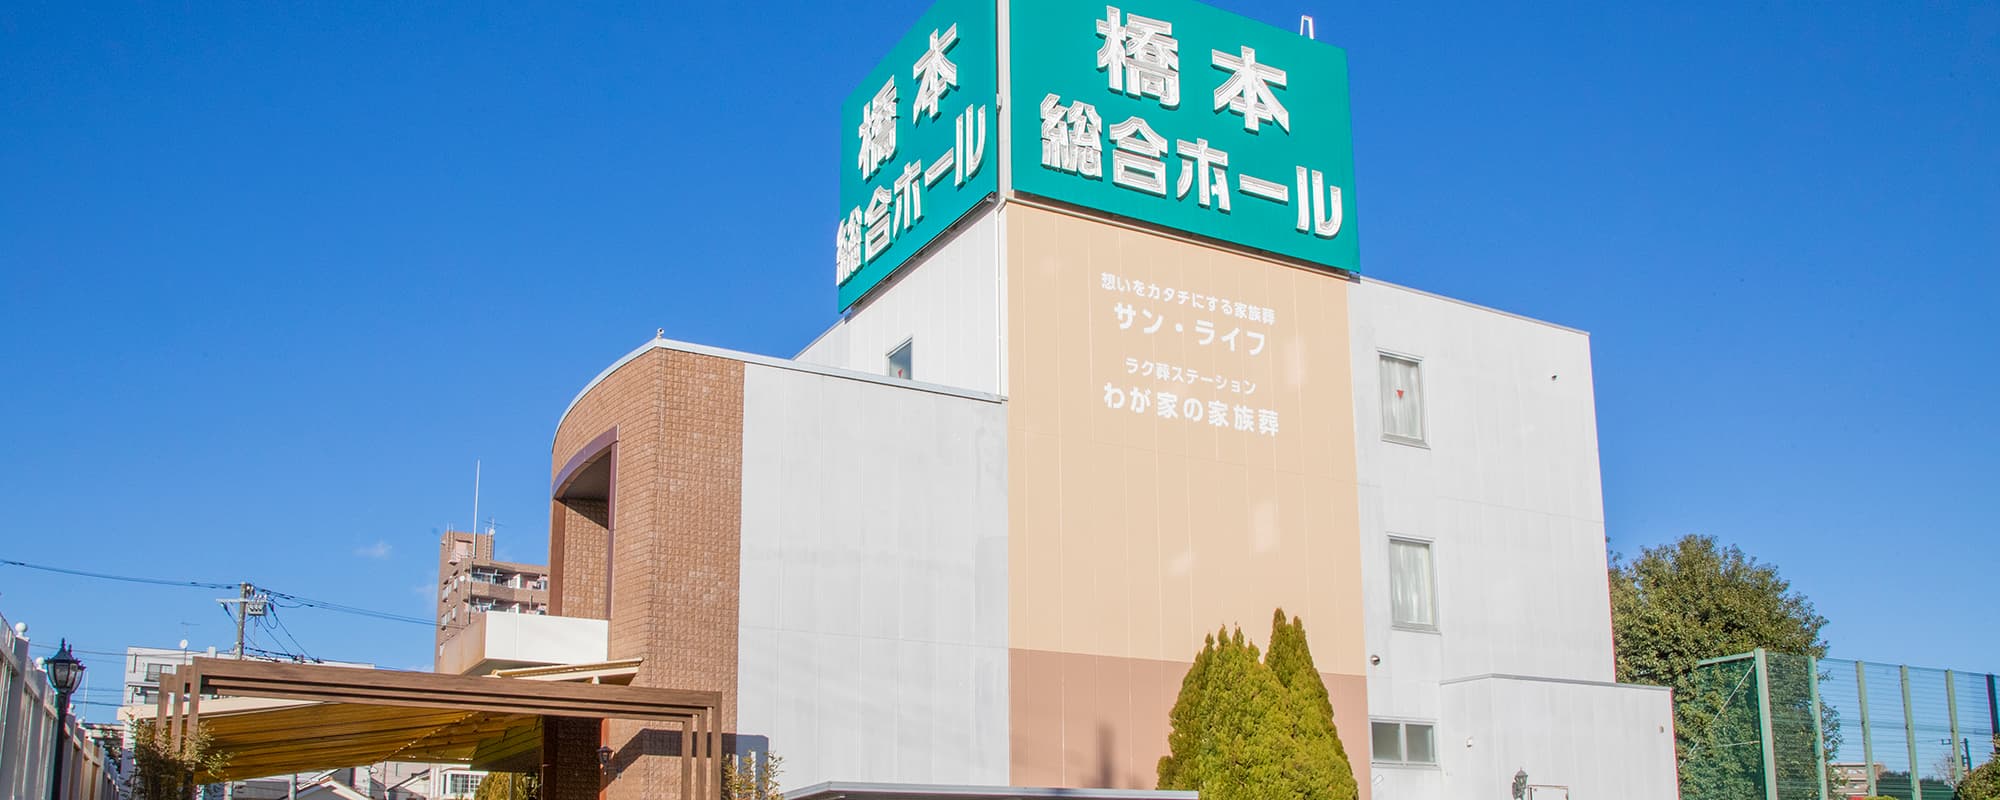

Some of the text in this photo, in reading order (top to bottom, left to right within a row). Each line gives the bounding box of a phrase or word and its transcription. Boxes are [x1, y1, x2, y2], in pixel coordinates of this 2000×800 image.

[858, 22, 957, 181] 橋本
[1096, 5, 1290, 134] 橋本
[836, 103, 986, 287] 総合ホール
[1040, 93, 1343, 239] 総合ホール
[1101, 272, 1276, 325] 想いをカタチにする家族葬
[1114, 302, 1265, 355] サン・ライフ
[1104, 382, 1279, 436] わが家の家族葬
[1126, 358, 1256, 394] ラク葬ステーション
